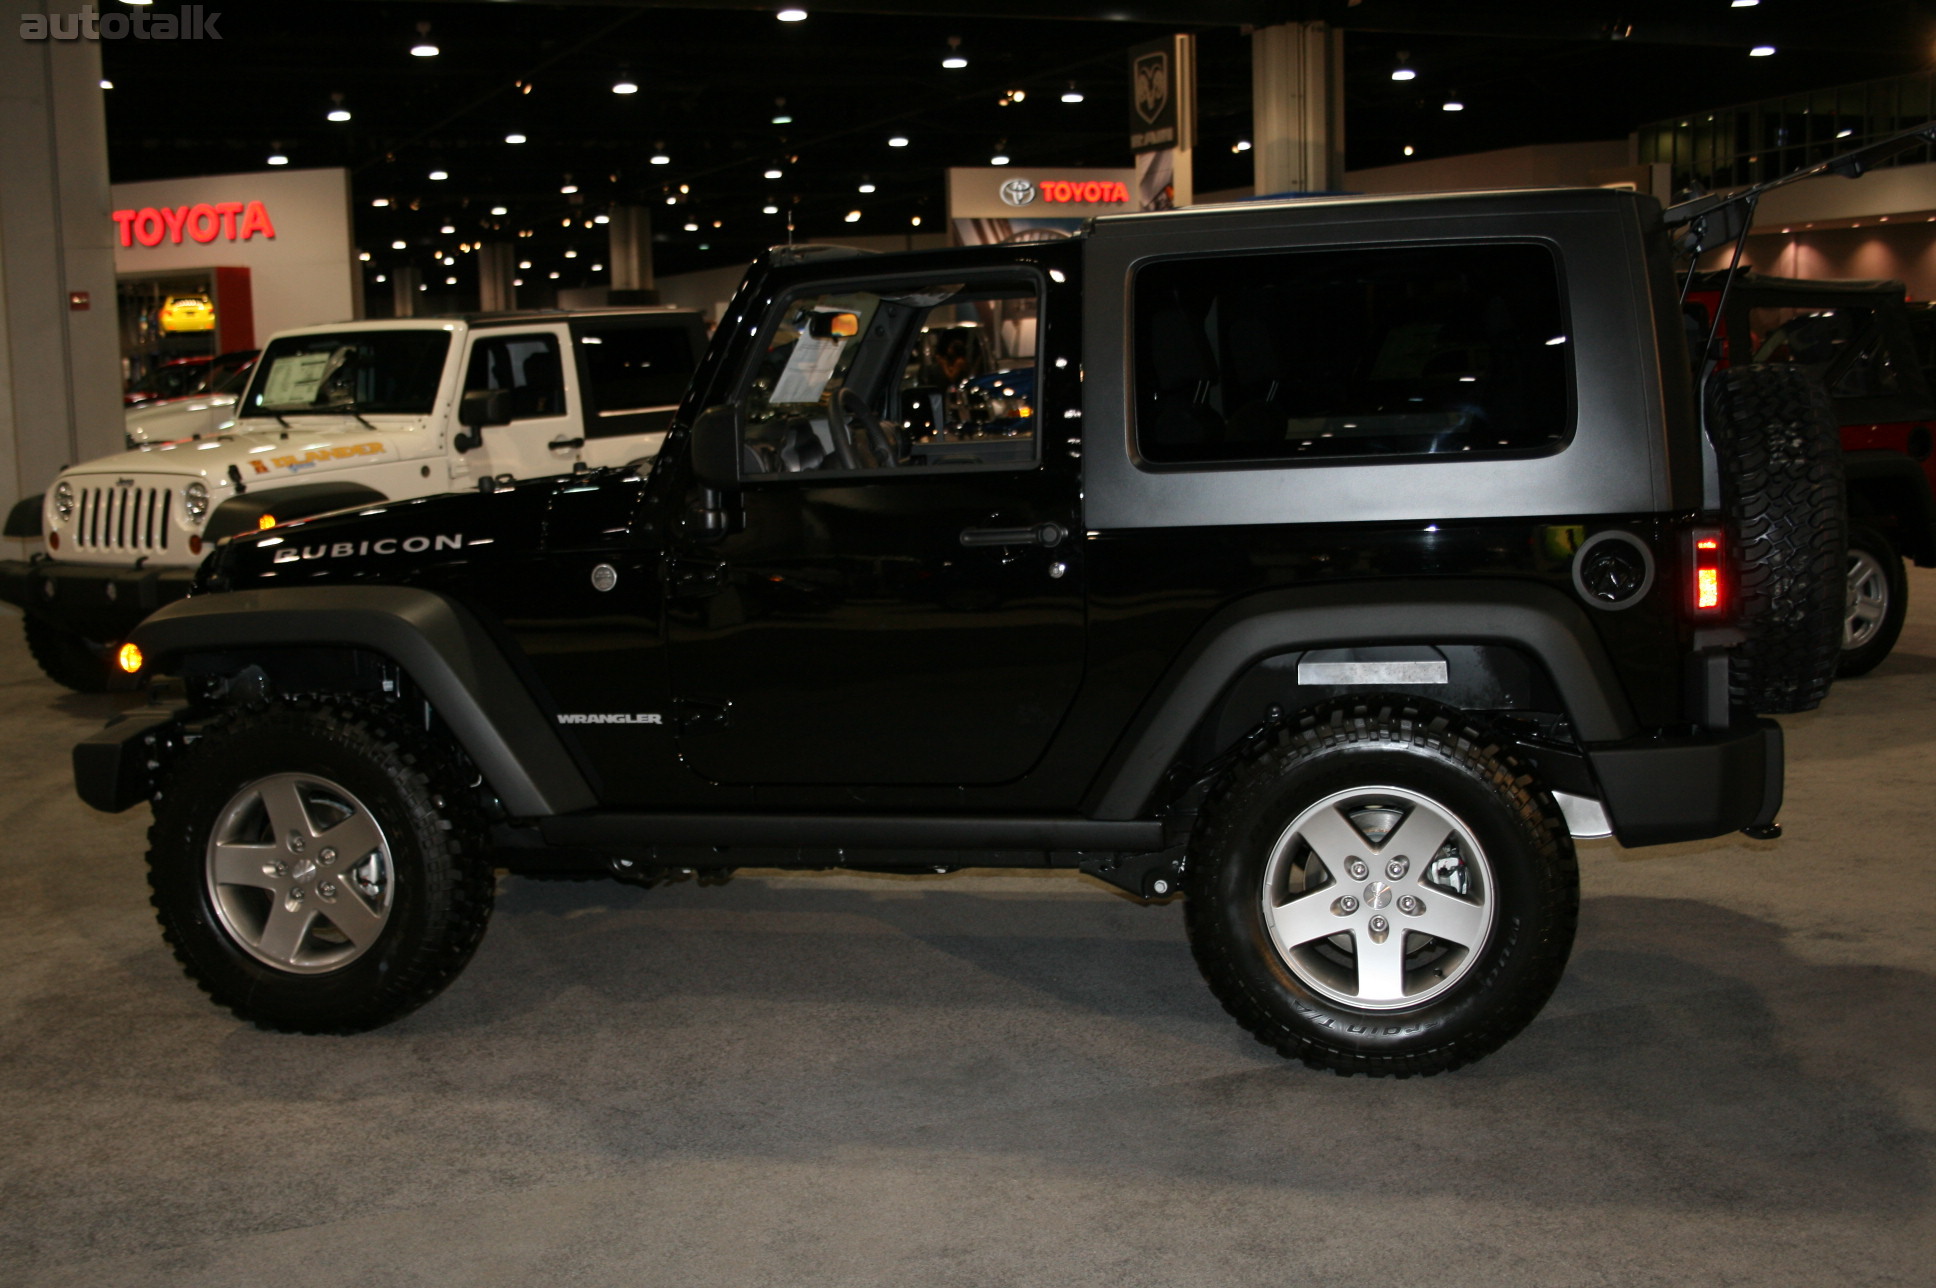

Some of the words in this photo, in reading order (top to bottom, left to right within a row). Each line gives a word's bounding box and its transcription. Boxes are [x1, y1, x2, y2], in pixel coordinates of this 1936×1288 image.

[1040, 181, 1130, 203] TOYOTA
[112, 200, 276, 247] TOYOTA
[273, 533, 463, 563] RUBICON
[557, 713, 663, 725] WRANGLER
